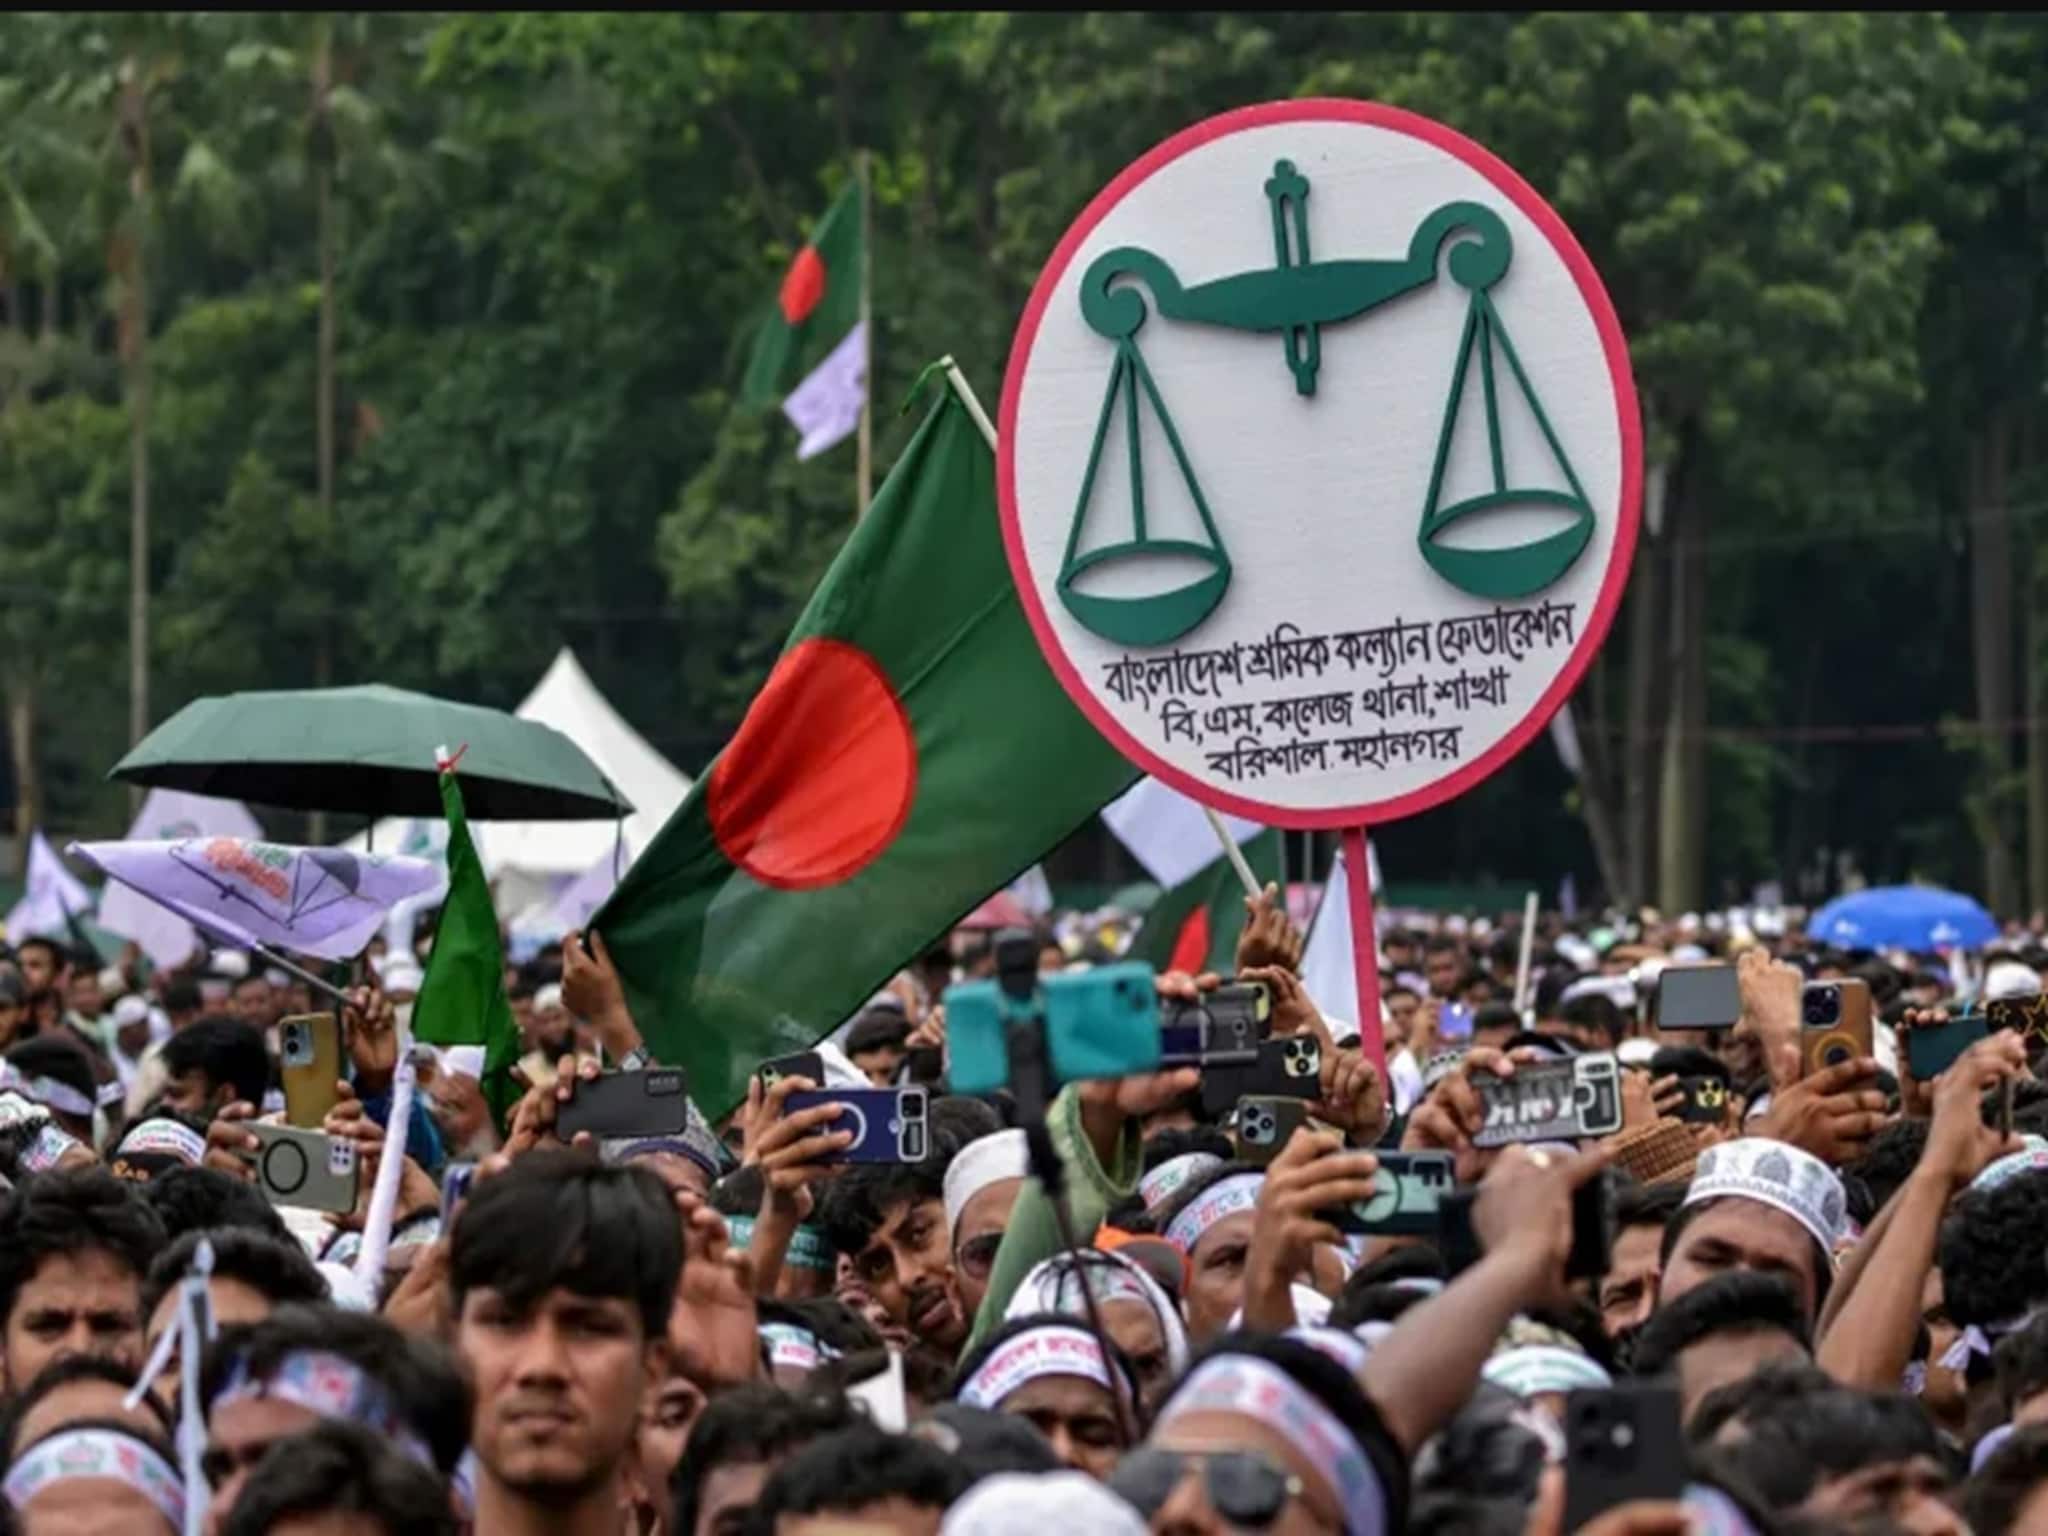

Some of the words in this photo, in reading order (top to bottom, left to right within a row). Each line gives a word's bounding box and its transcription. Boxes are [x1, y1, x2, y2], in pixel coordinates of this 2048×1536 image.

[1103, 642, 1243, 711] বাংলাদেশ
[1246, 622, 1330, 680] শ্রমিক
[1333, 617, 1432, 679] কল্যান
[1437, 600, 1577, 665] ফেডারেশন
[1334, 726, 1463, 770] মহানগর
